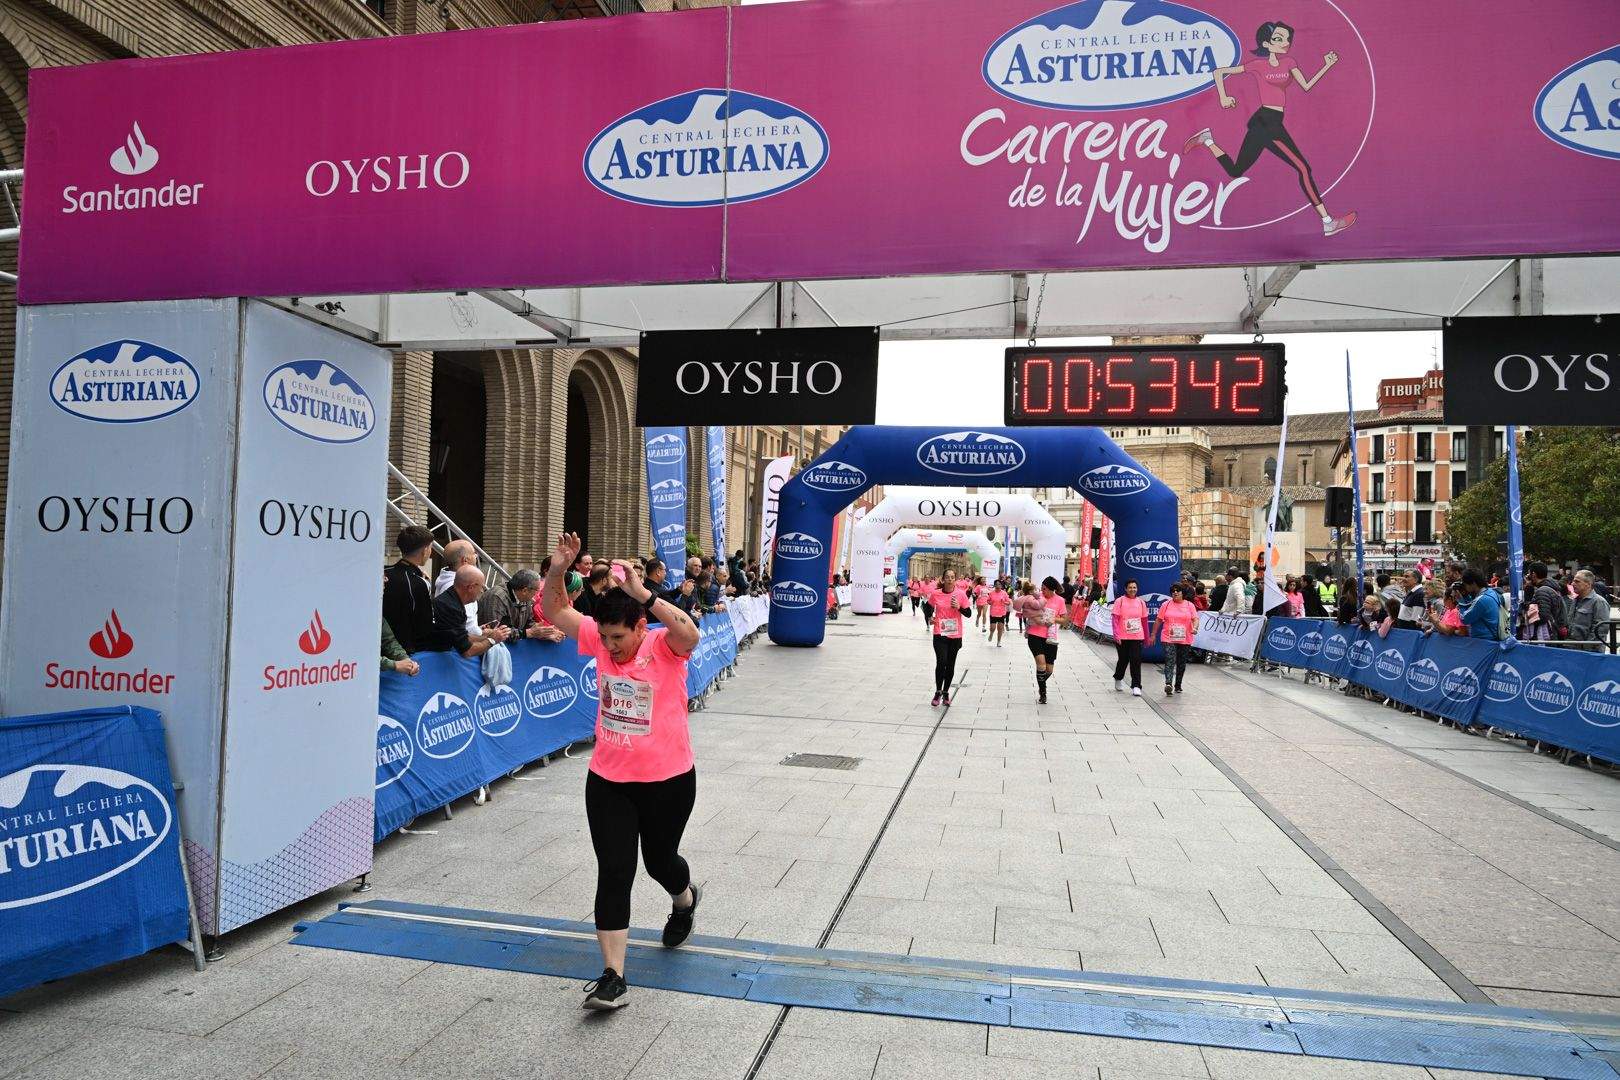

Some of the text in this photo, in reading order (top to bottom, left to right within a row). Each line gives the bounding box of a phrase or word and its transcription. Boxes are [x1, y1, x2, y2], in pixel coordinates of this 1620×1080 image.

[1041, 29, 1212, 50] CENTRAL LECHERA
[1001, 43, 1219, 85] ASTURIANA
[639, 124, 801, 145] CENTRAL LECHERA
[960, 107, 1168, 166] Carrera
[305, 151, 470, 197] OYSHO
[601, 138, 809, 180] ASTURIANA
[62, 178, 204, 214] Santander
[1008, 153, 1250, 253] de la Mujer
[60, 371, 189, 403] ASTURIANA
[84, 368, 185, 378] CENTRAL LECHERA
[675, 360, 843, 395] OYSHO
[1494, 352, 1620, 393] OYS
[272, 378, 368, 431] ASTURIANA
[291, 380, 366, 408] CENTRAL LECHERA
[1383, 384, 1421, 397] TIBUR
[925, 444, 1017, 465] ASTURIANA
[1388, 438, 1396, 483] HOTEL
[805, 471, 861, 485] ASTURIANA
[1084, 477, 1146, 489] ASTURIANA
[36, 495, 195, 535] OYSHO
[259, 499, 372, 543] OYSHO
[917, 499, 1001, 518] OYSHO
[1204, 616, 1249, 637] OYSHO
[45, 662, 175, 694] Santander
[263, 658, 357, 691] Santander
[1488, 679, 1518, 695] TURIANA
[528, 685, 575, 710] ASTURIANA
[613, 698, 633, 709] 016
[1526, 683, 1569, 706] ASTURIANA
[478, 702, 520, 726] ASTURIANA
[422, 716, 474, 749] ASTURIANA
[65, 792, 143, 818] LECHERA
